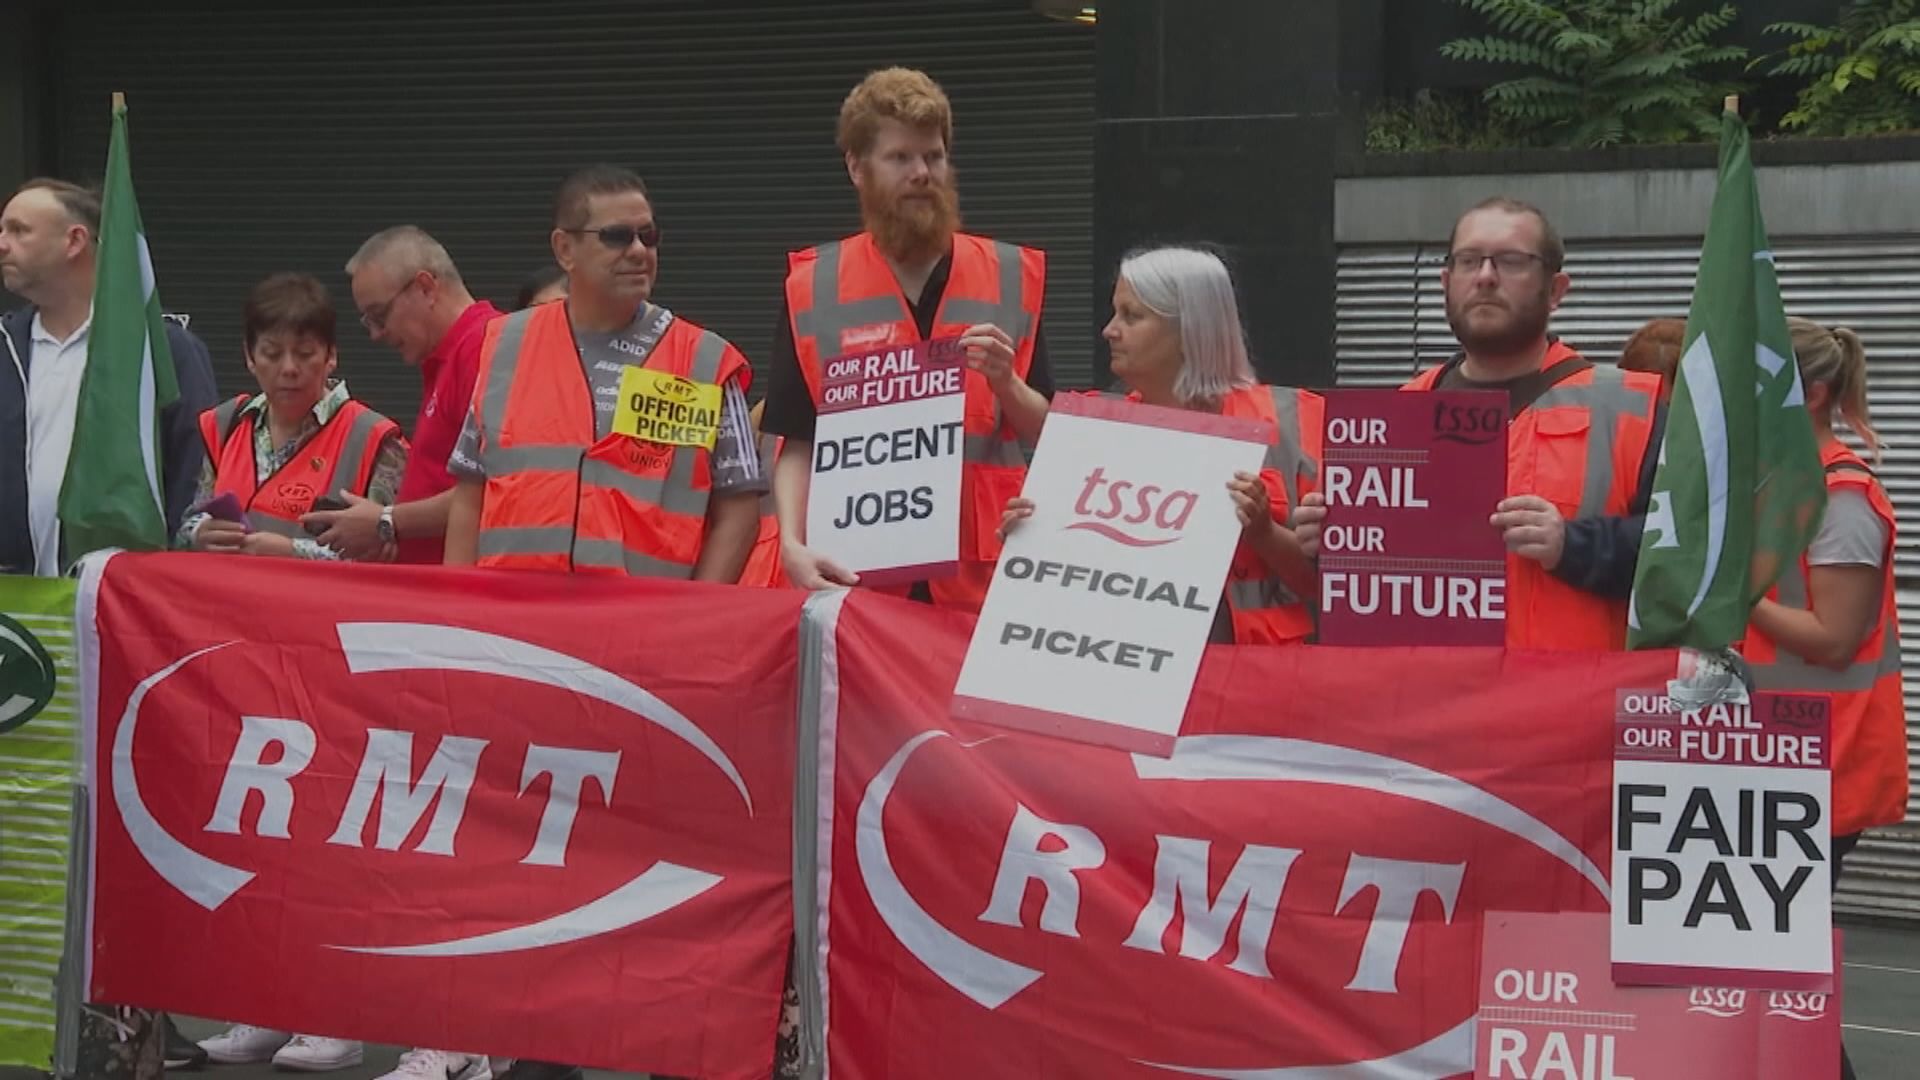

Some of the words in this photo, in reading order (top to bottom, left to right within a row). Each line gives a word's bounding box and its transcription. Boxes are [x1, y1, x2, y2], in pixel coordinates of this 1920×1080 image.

[828, 358, 861, 378] OUR
[863, 348, 921, 380] RAIL
[663, 382, 695, 397] RMT
[824, 383, 858, 404] OUR
[862, 367, 961, 405] FUTURE
[630, 392, 719, 428] OFFICIAL
[636, 415, 711, 444] PICKET
[1433, 400, 1502, 433] tssa
[814, 421, 963, 474] DECENT
[1327, 417, 1387, 445] OUR
[1073, 467, 1199, 531] tssa
[1325, 465, 1429, 508] RAIL
[833, 485, 934, 529] JOBS
[1323, 525, 1385, 553] OUR
[1003, 555, 1211, 613] OFFICIAL
[1322, 572, 1506, 620] FUTURE
[999, 621, 1174, 673] PICKET
[1624, 695, 1672, 714] OUR
[1680, 701, 1763, 730] RAIL
[1771, 697, 1825, 721] tssa
[1623, 728, 1672, 747] OUR
[1680, 730, 1822, 766] FUTURE
[203, 715, 623, 867] RMT
[1617, 783, 1826, 861] FAIR
[977, 801, 1467, 994] RMT
[1627, 857, 1814, 934] PAY
[1494, 968, 1579, 1004] OUR
[1489, 1028, 1636, 1080] RAIL
